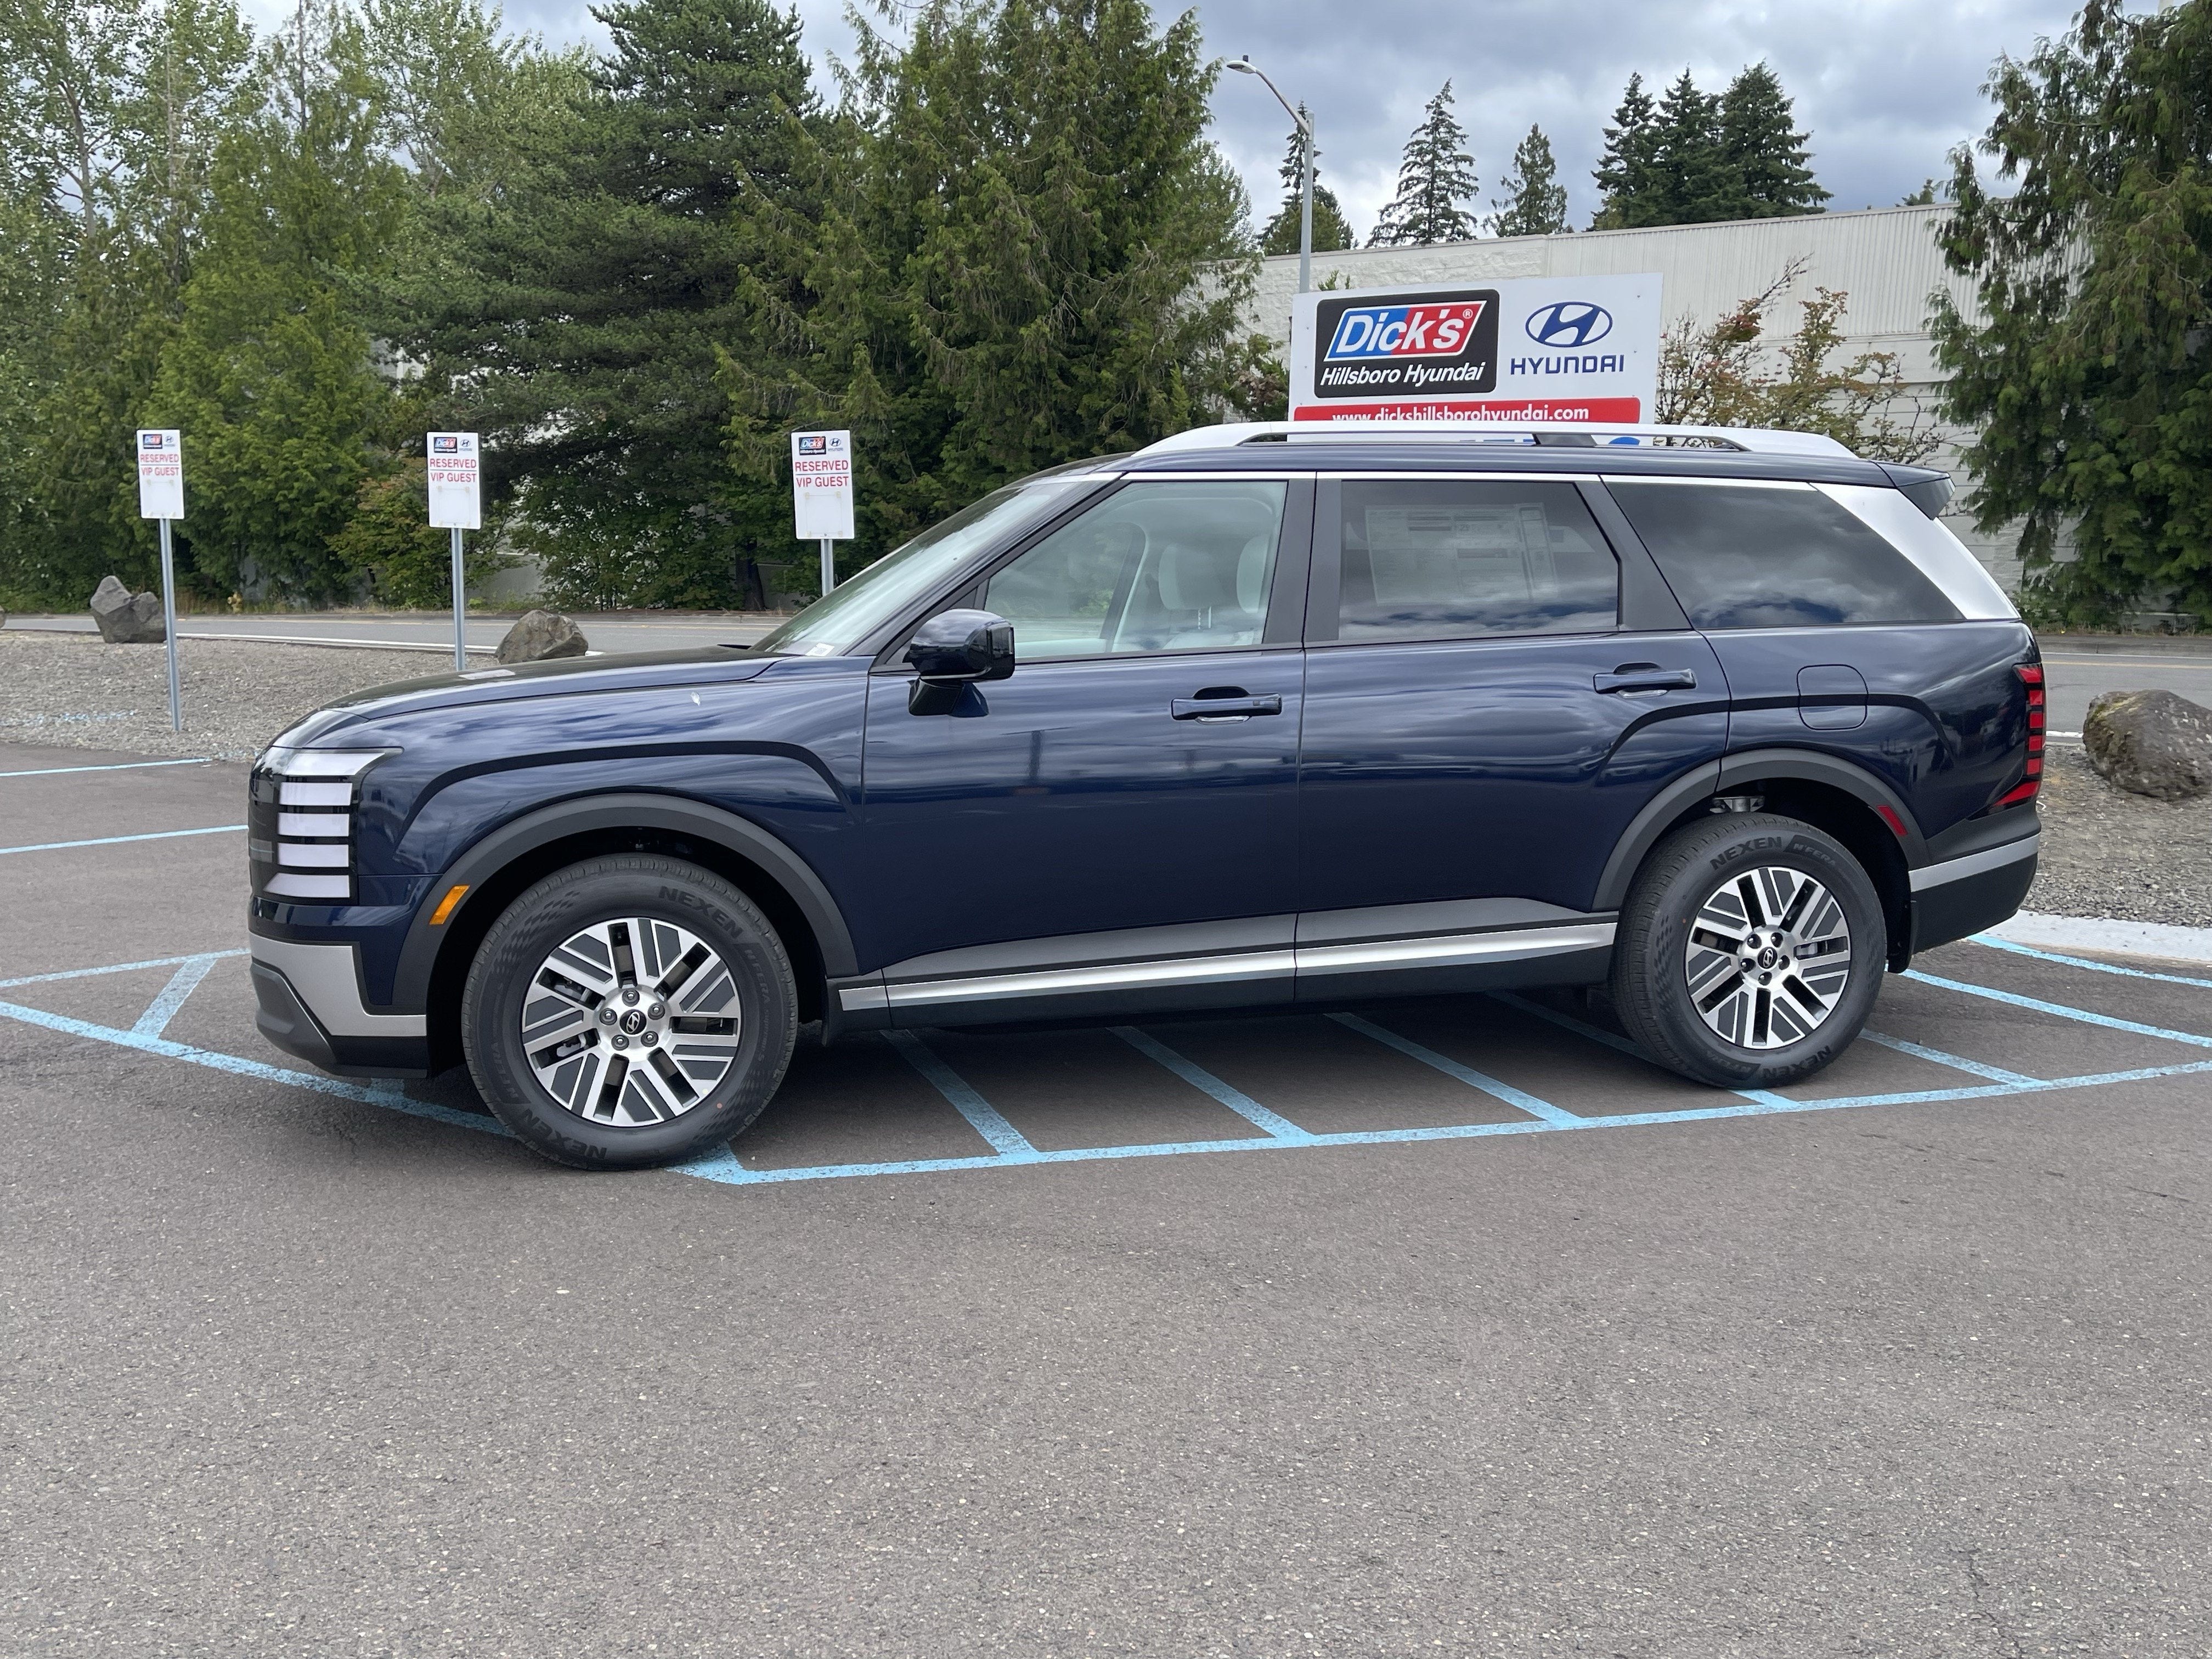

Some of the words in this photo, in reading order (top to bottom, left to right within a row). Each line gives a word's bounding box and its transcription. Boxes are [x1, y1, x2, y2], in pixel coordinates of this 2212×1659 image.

[1510, 354, 1624, 375] HYUNDAI
[1320, 365, 1401, 386] Hillsboro
[1403, 362, 1486, 387] Hyundai
[1332, 404, 1589, 421] wwwdickshillsborohyundai.com
[140, 454, 179, 462] RESERVED
[430, 458, 477, 469] RESERVED
[141, 467, 153, 476] VIP
[154, 467, 179, 476] GUEST
[795, 460, 849, 472] RESERVED
[430, 472, 444, 482] VIP
[447, 472, 477, 483] GUEST
[796, 477, 811, 488] VIP
[815, 476, 849, 487] GUEST
[1709, 837, 1782, 871] NEXEN
[658, 885, 743, 939] NEXEN
[522, 1108, 608, 1159] NEXEN
